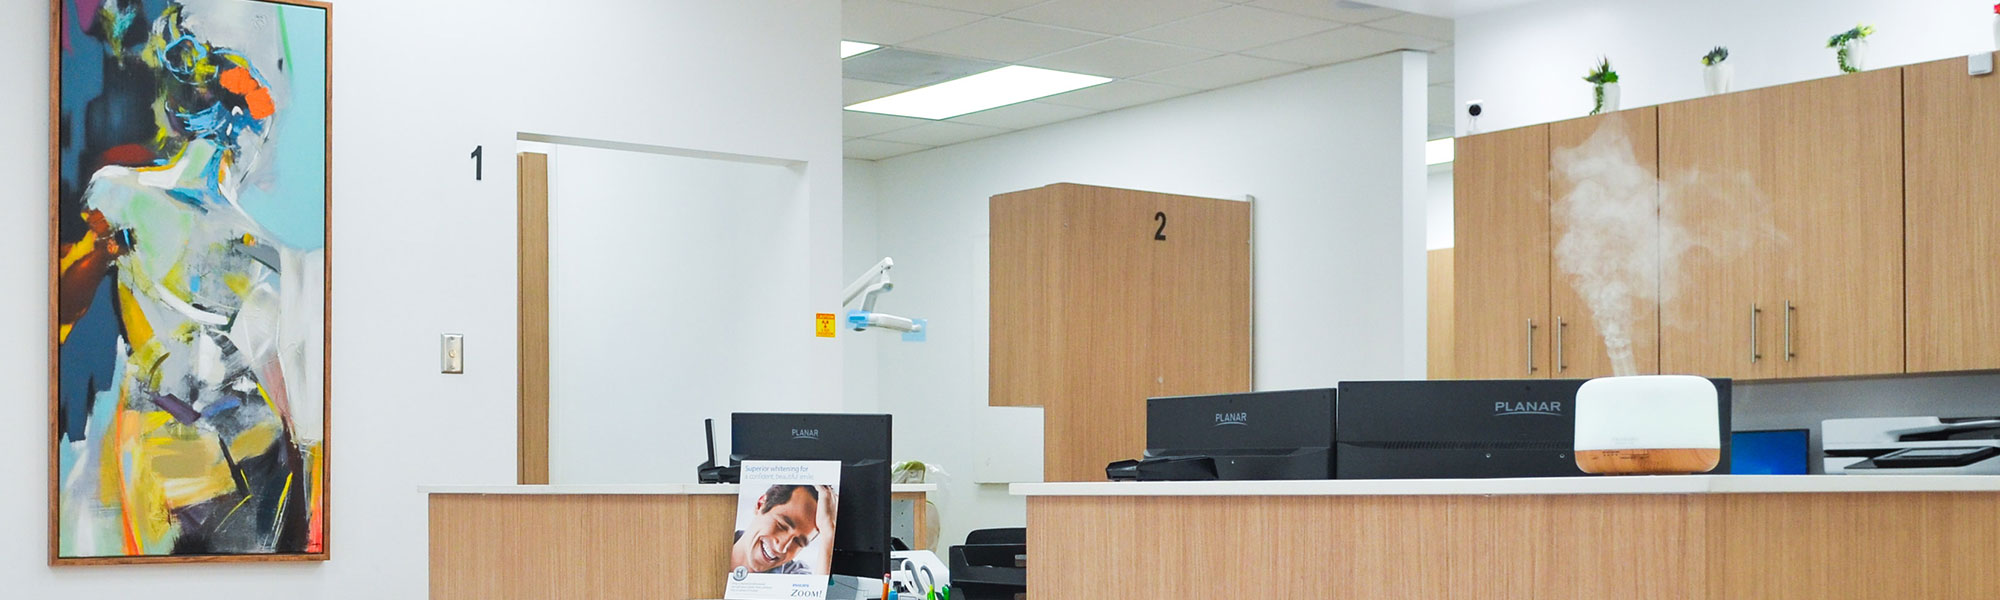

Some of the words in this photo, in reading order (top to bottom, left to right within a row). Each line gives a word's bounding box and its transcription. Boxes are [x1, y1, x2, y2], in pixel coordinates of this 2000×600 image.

[470, 144, 483, 181] 1
[1154, 211, 1167, 241] 2
[1495, 401, 1561, 412] PLANAR
[1215, 412, 1247, 422] PLANAR
[791, 428, 819, 437] PLANAR
[745, 465, 769, 473] Superior
[770, 465, 800, 474] whitening
[790, 588, 823, 598] ZOOM!
